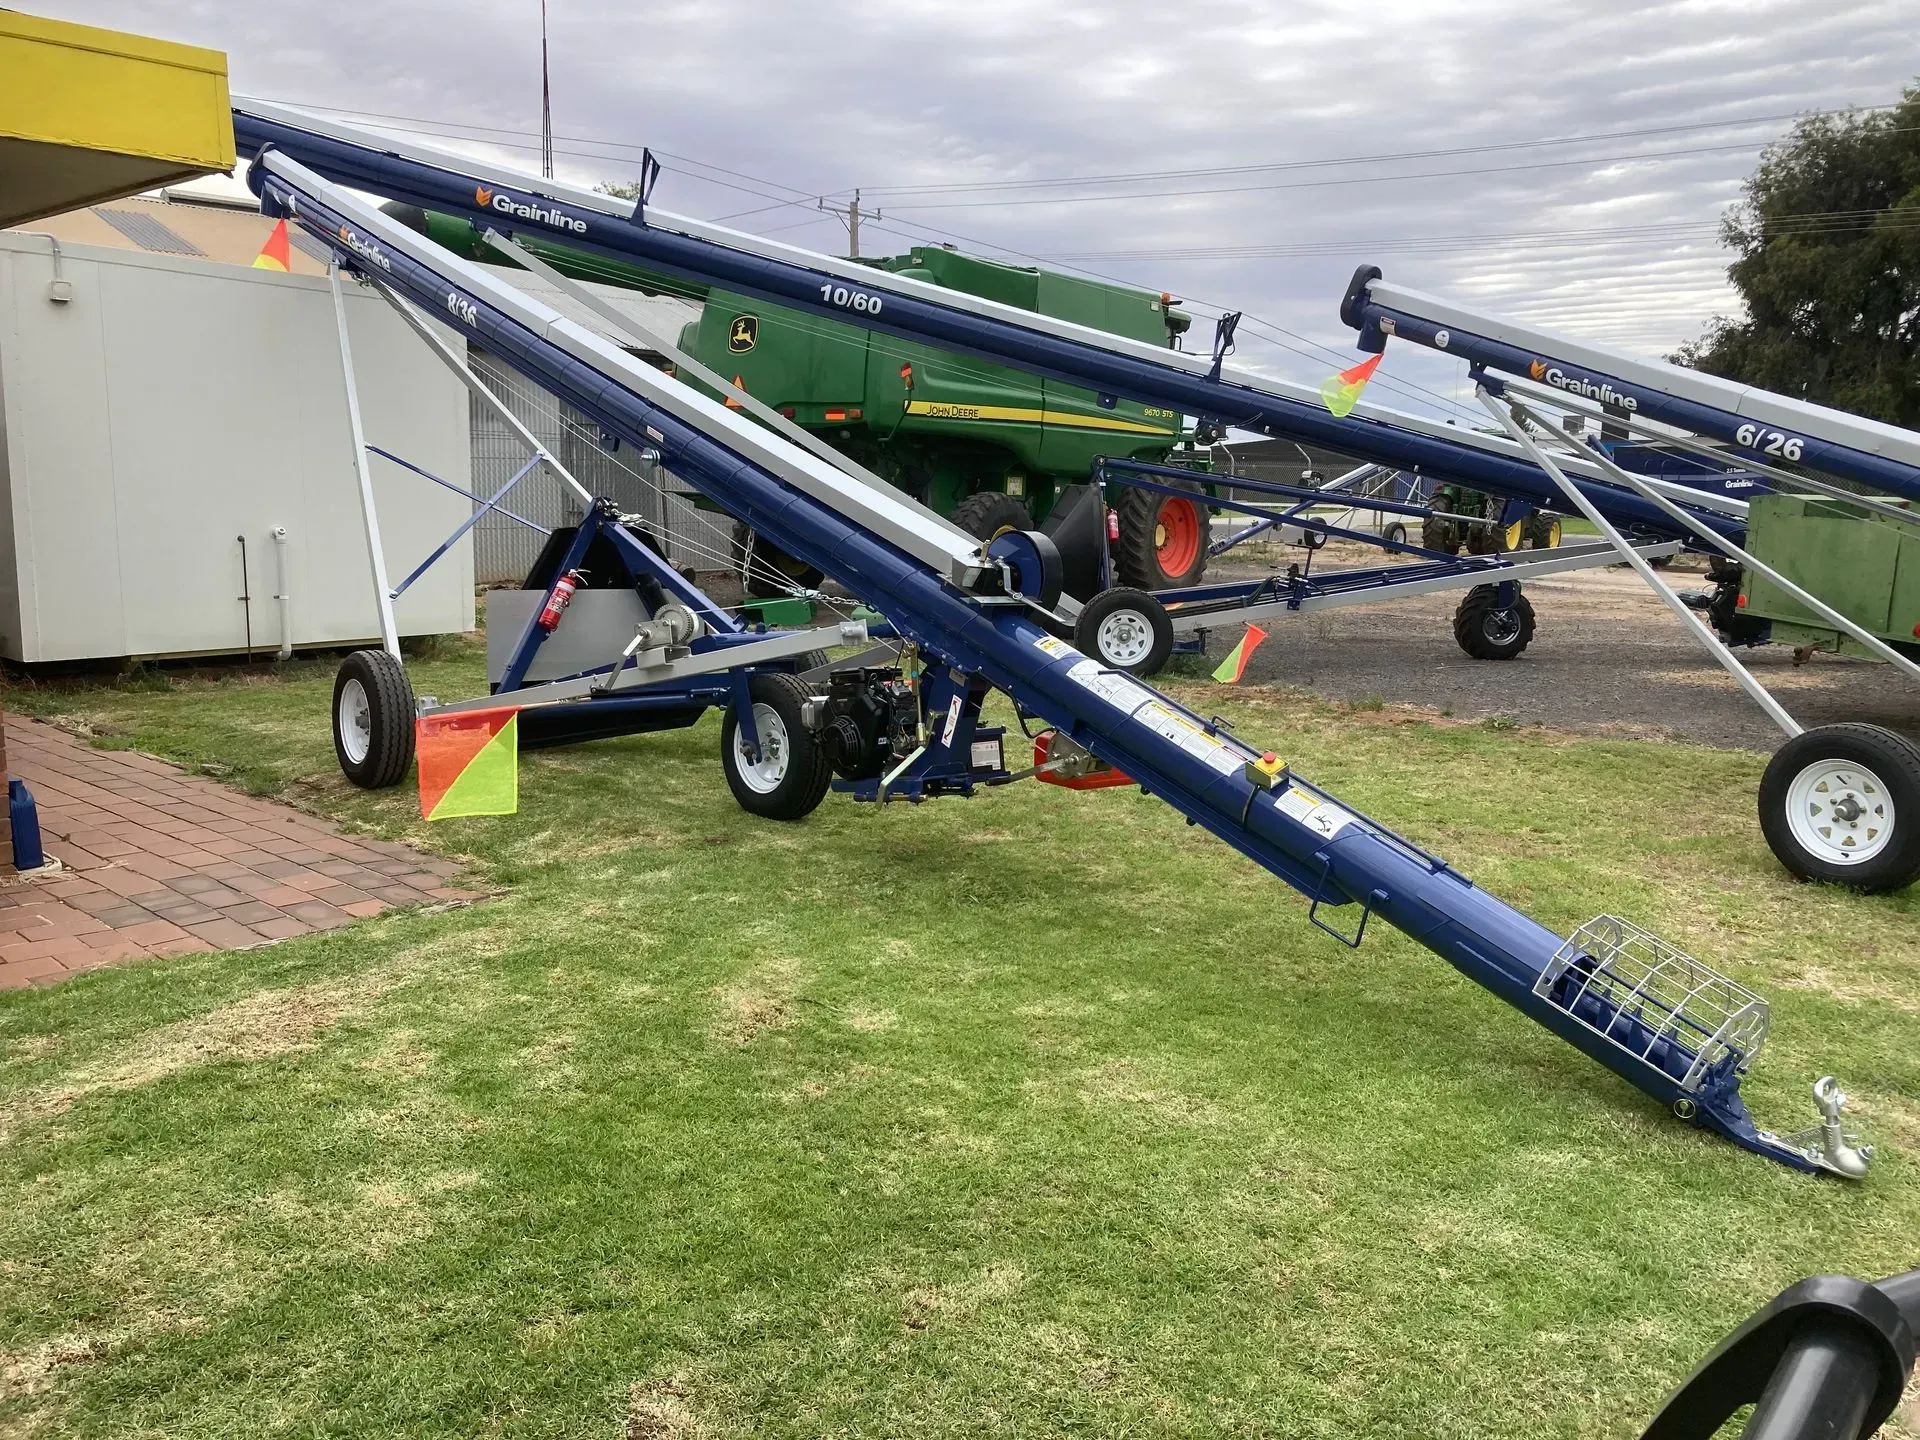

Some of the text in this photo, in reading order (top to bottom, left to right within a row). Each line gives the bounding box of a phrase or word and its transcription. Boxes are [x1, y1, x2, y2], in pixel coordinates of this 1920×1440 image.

[492, 194, 587, 233] Grainline
[347, 232, 391, 272] Grainline
[447, 292, 477, 328] 8/36
[820, 284, 882, 315] 10/60
[1545, 368, 1638, 411] Grainline
[926, 404, 979, 418] JOHN DEERE
[1144, 408, 1174, 418] 9670 STS
[1736, 424, 1804, 461] 6/26
